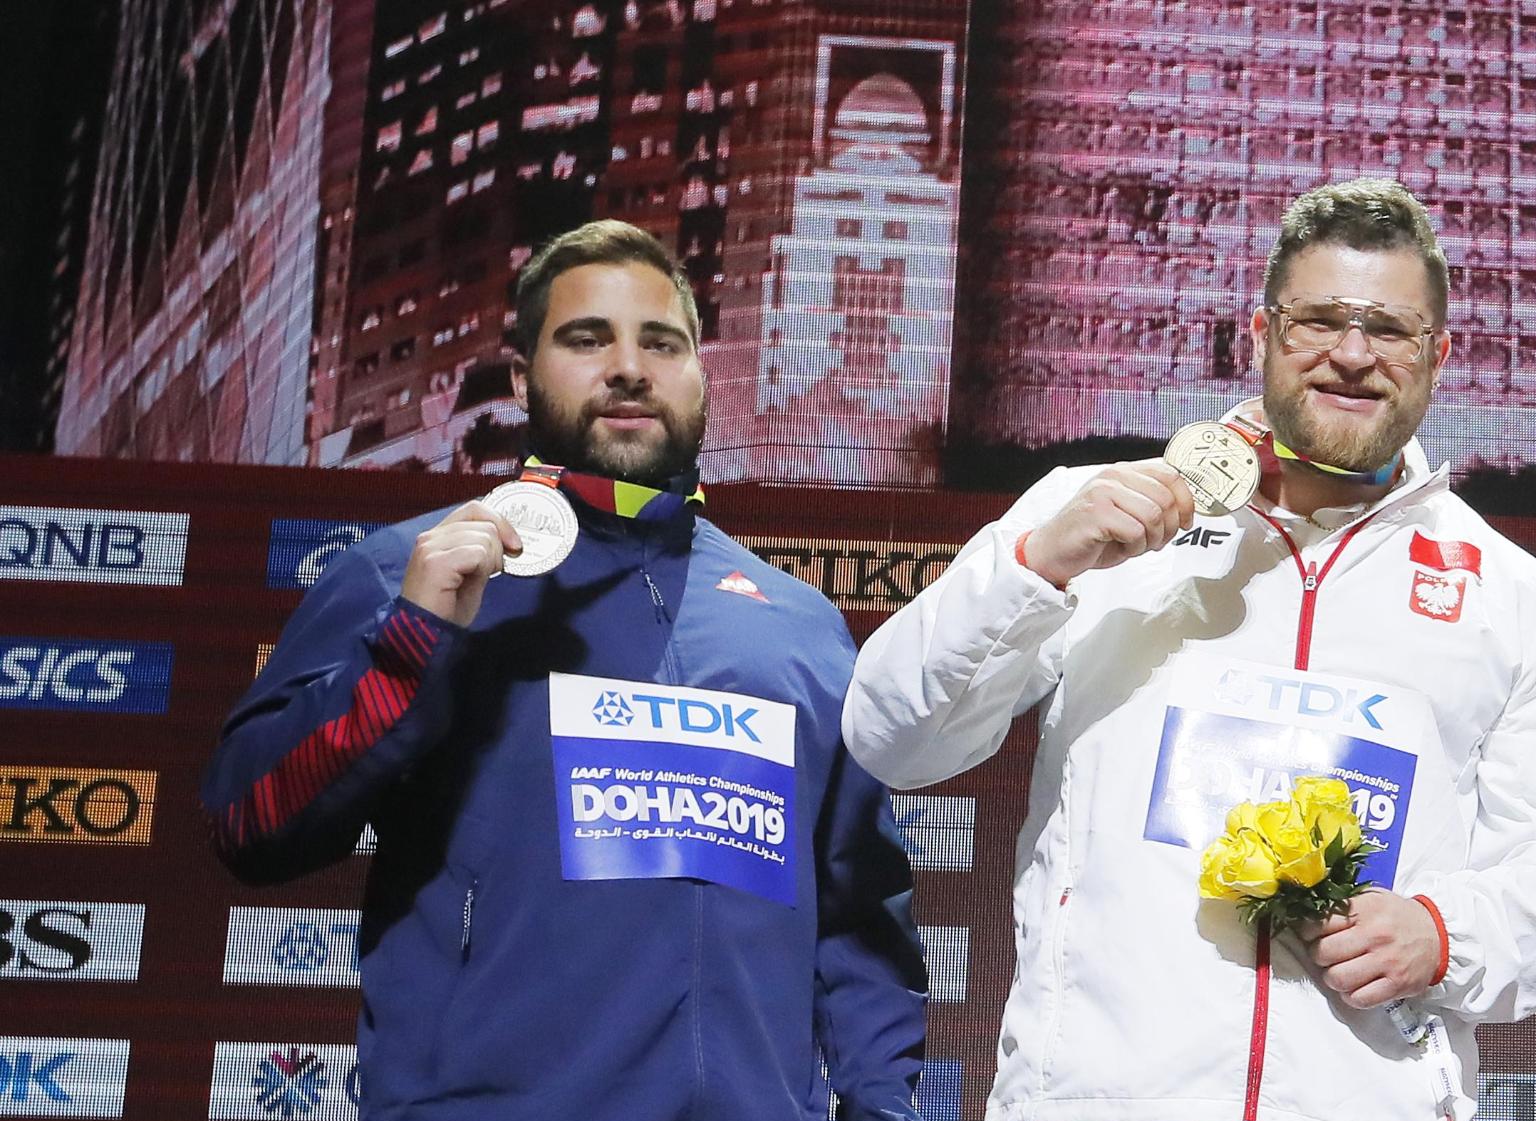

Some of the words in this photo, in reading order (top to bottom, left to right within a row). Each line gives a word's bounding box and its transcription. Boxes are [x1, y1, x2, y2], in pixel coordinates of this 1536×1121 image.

[0, 520, 146, 570] QNB
[632, 694, 762, 744] TDK
[1257, 675, 1389, 730] TDK
[571, 767, 613, 780] IAAF
[614, 768, 654, 782] World
[654, 770, 708, 787] Athletics
[708, 776, 785, 806] Championships
[571, 784, 786, 846] DOHA2019
